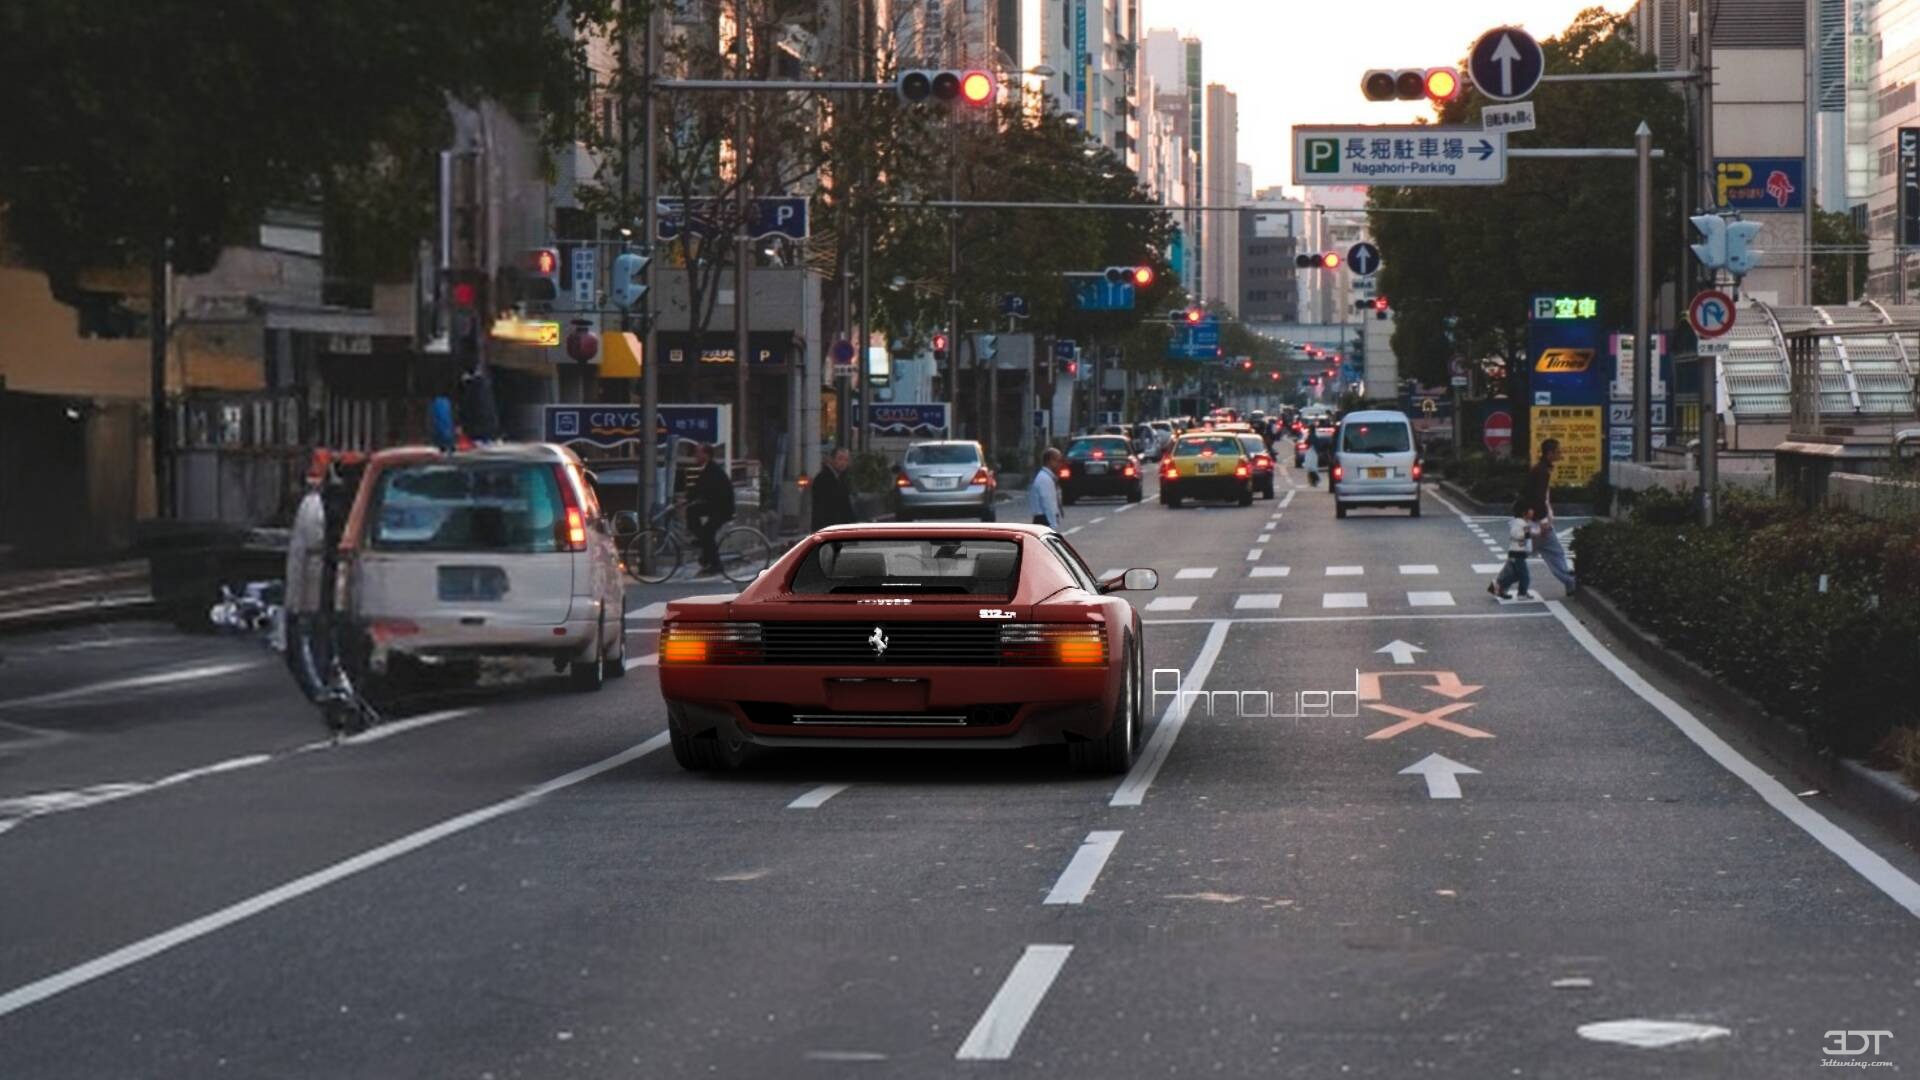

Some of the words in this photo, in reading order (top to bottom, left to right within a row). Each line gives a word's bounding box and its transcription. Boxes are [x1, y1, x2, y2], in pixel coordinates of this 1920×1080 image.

[1312, 141, 1332, 170] P
[1345, 138, 1464, 160] 長堀駐車場
[1353, 162, 1456, 175] Nagahori-Parking
[777, 205, 793, 226] P
[1555, 297, 1597, 318] 空車
[1542, 352, 1588, 369] Times
[590, 412, 667, 427] CRYSA
